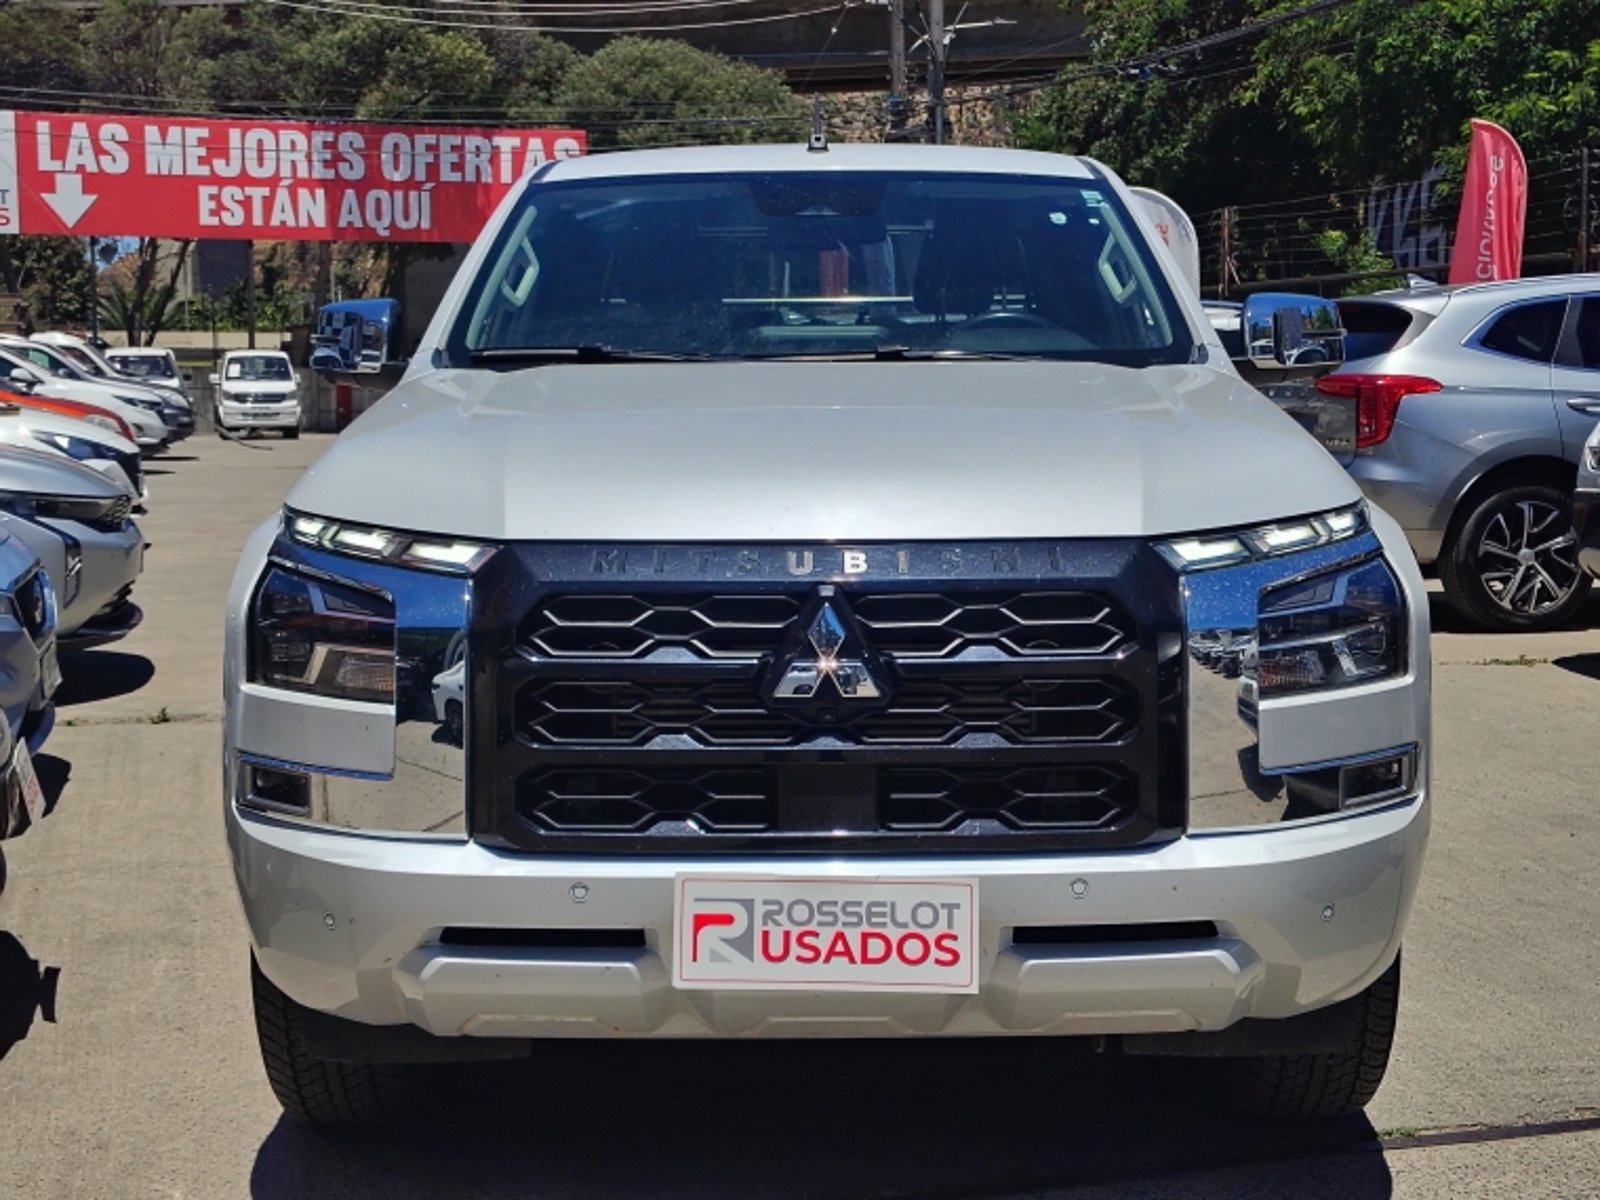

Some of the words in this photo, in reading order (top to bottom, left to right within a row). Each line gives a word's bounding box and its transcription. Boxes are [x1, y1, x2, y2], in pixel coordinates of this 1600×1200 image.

[36, 120, 129, 174] LAS
[144, 125, 365, 181] MEJORES
[198, 178, 327, 229] ESTÁN
[337, 182, 436, 237] AQUÍ
[590, 546, 1061, 575] MITSUBISHI
[762, 899, 961, 929] ROSSELOT
[761, 930, 961, 967] USADOS
